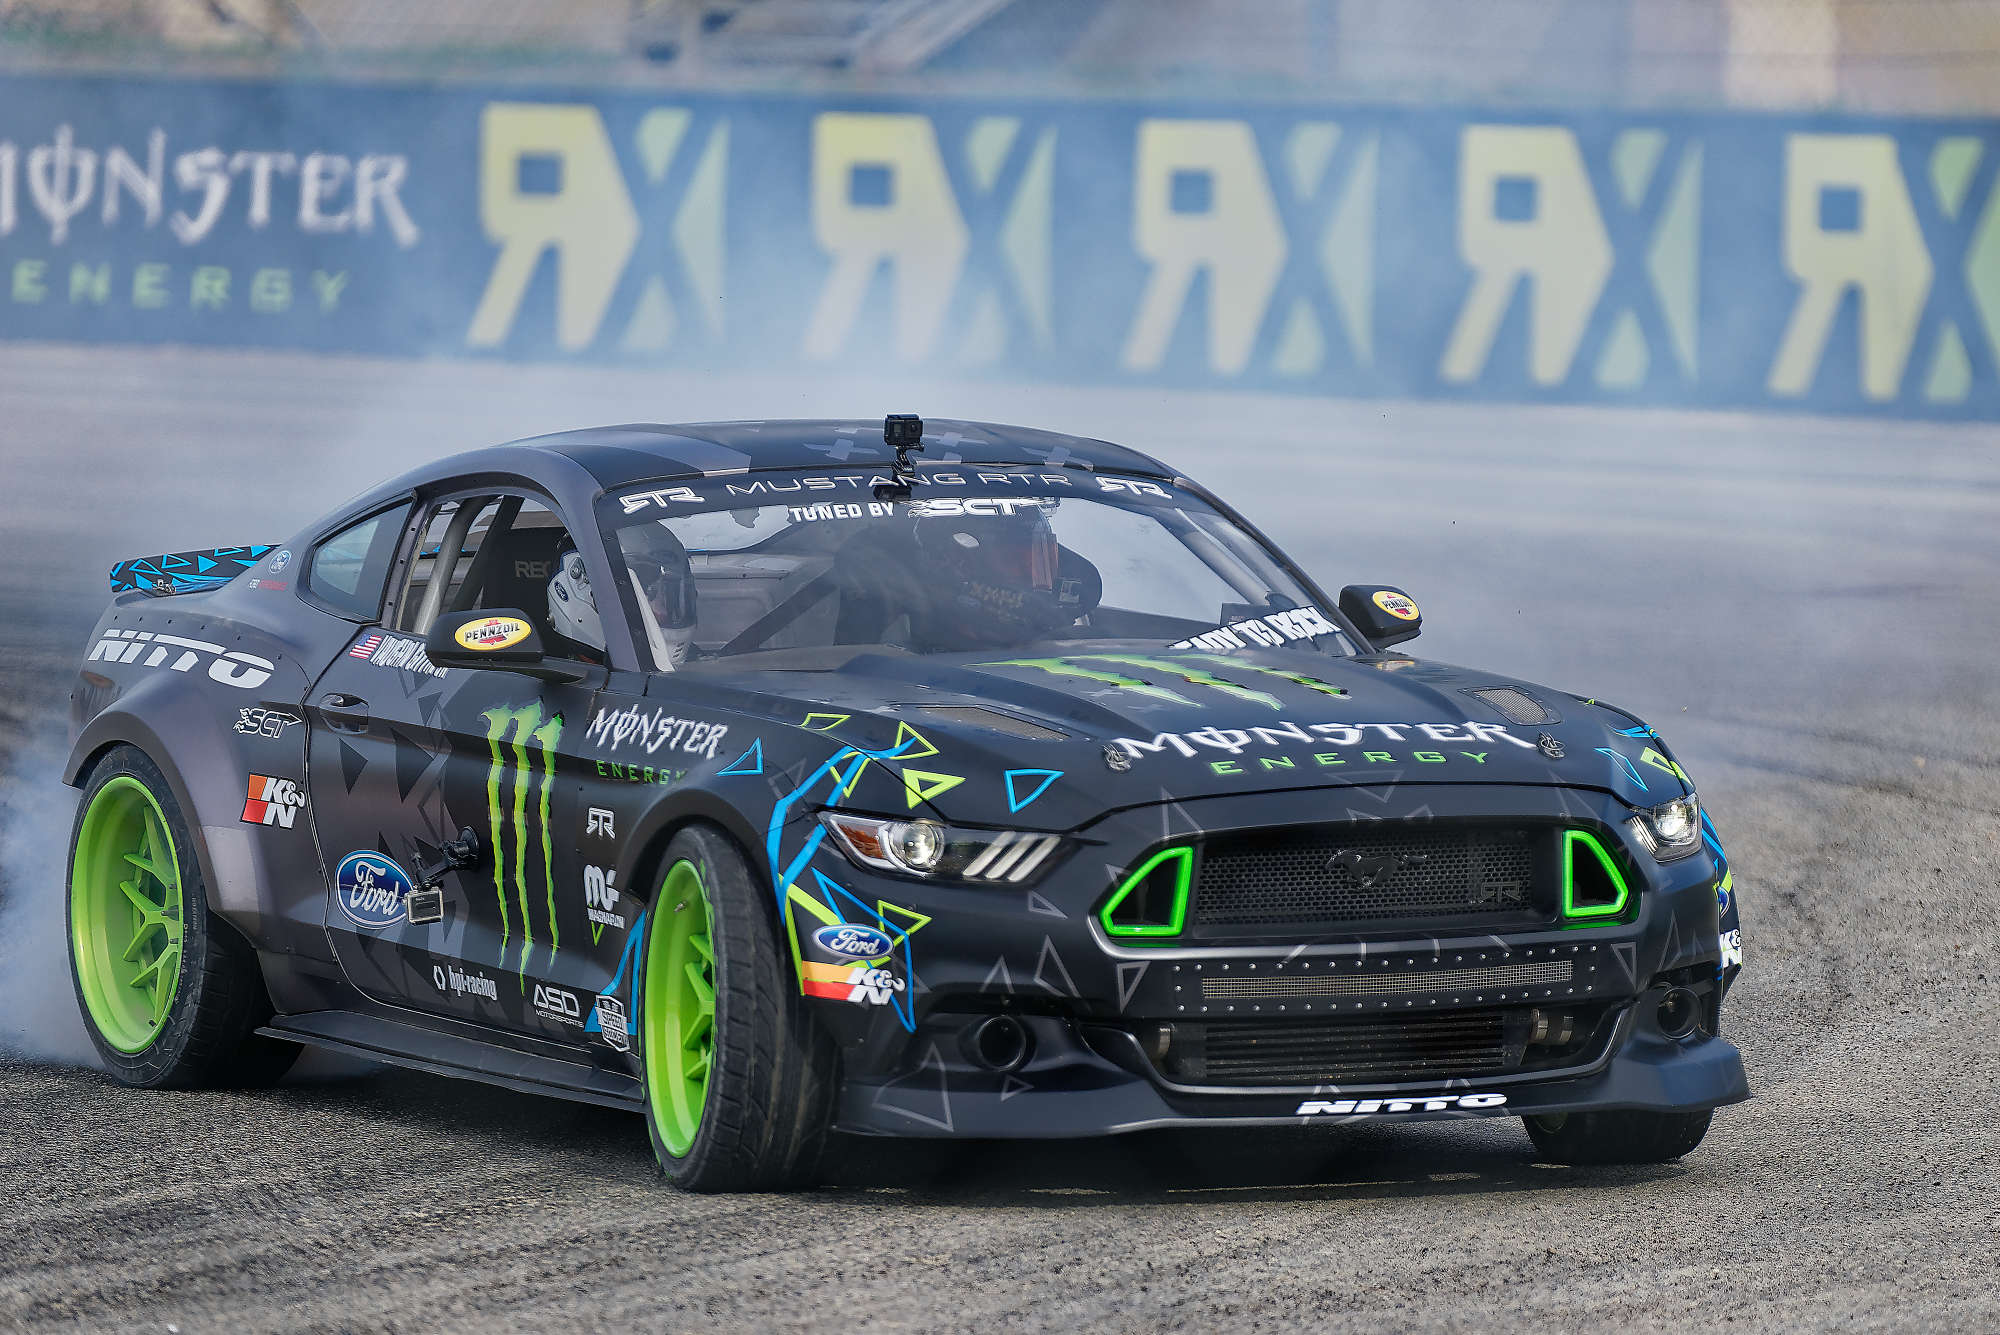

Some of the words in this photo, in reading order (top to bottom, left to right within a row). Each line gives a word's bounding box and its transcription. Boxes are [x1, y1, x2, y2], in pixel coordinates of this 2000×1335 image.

[11, 259, 349, 314] ENERGY
[726, 473, 967, 496] MUSTANG
[977, 472, 1074, 486] RTR
[788, 502, 863, 522] TUNED
[870, 501, 896, 517] BY
[464, 621, 521, 643] PENNZOIL
[87, 628, 275, 689] NITTO
[237, 708, 294, 738] SCT
[596, 759, 688, 785] ENERGY
[1209, 750, 1489, 776] ENERGY
[350, 860, 400, 916] Ford
[830, 928, 881, 955] Ford
[448, 964, 498, 1001] hpi-racing
[535, 1009, 585, 1029] MOTORSPORTS
[1296, 1093, 1508, 1115] NITTO
